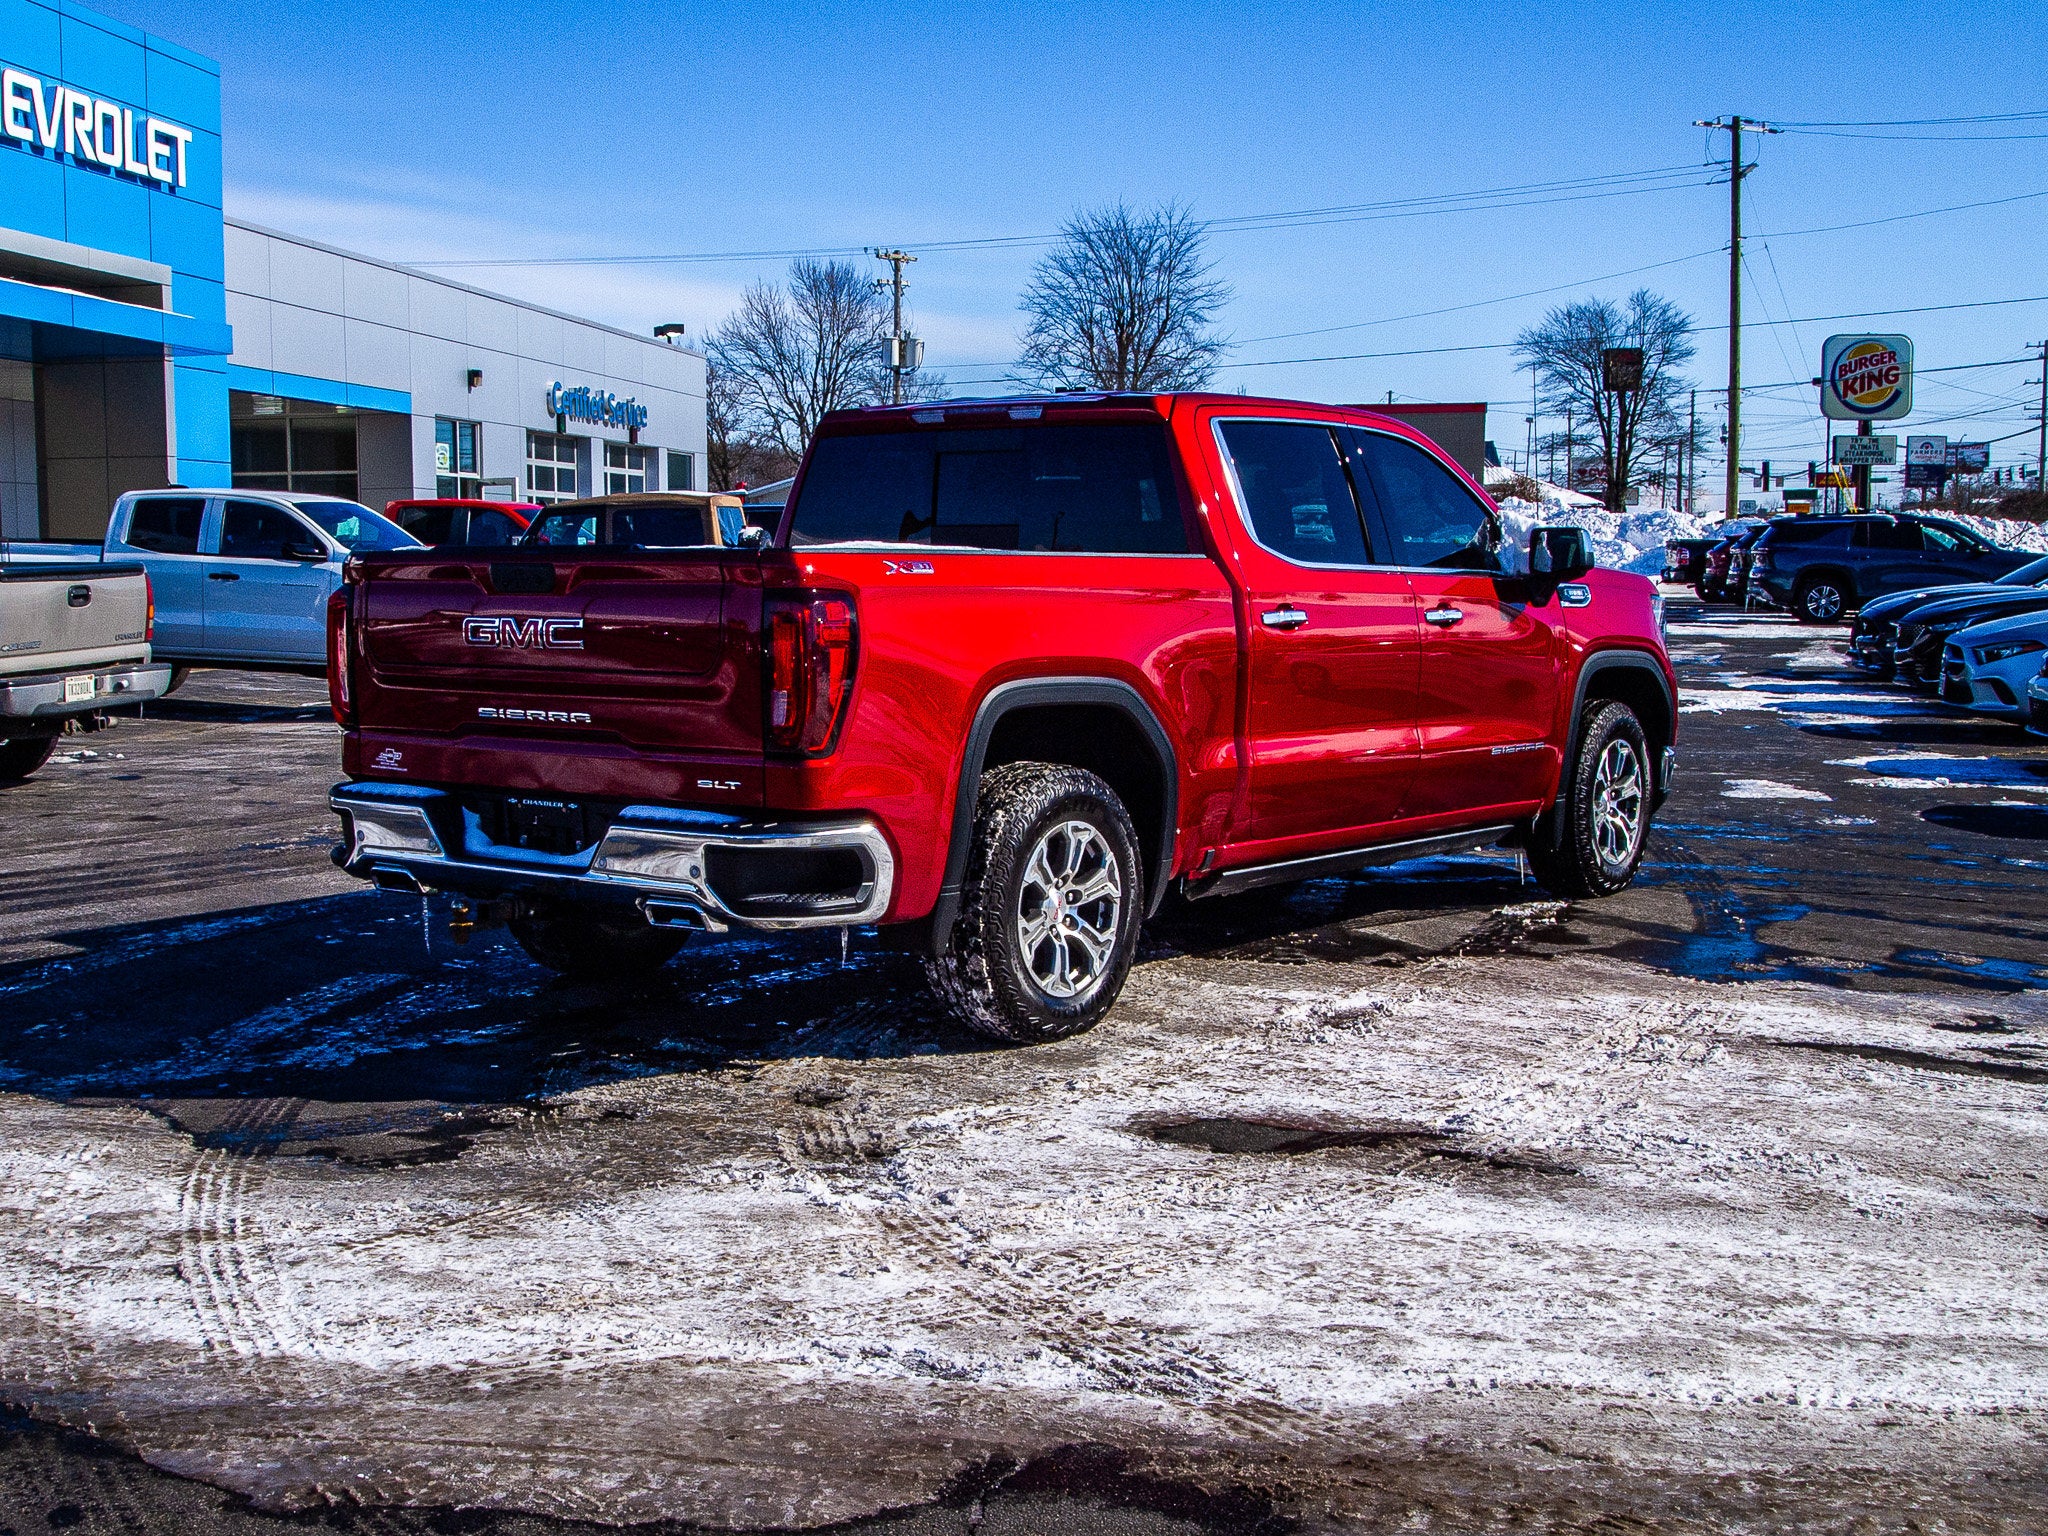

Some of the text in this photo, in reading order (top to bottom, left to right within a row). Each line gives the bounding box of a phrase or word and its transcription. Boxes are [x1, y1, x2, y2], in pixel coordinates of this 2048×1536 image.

[0, 68, 193, 188] EVROLET
[1838, 350, 1897, 378] BURGER
[1842, 366, 1900, 399] KING
[552, 381, 648, 428] Certified Service
[462, 617, 584, 650] GMC
[478, 707, 592, 723] SIERRA
[1491, 742, 1545, 756] SIERRA
[697, 779, 741, 790] SLT
[522, 799, 564, 808] CHANDLER
